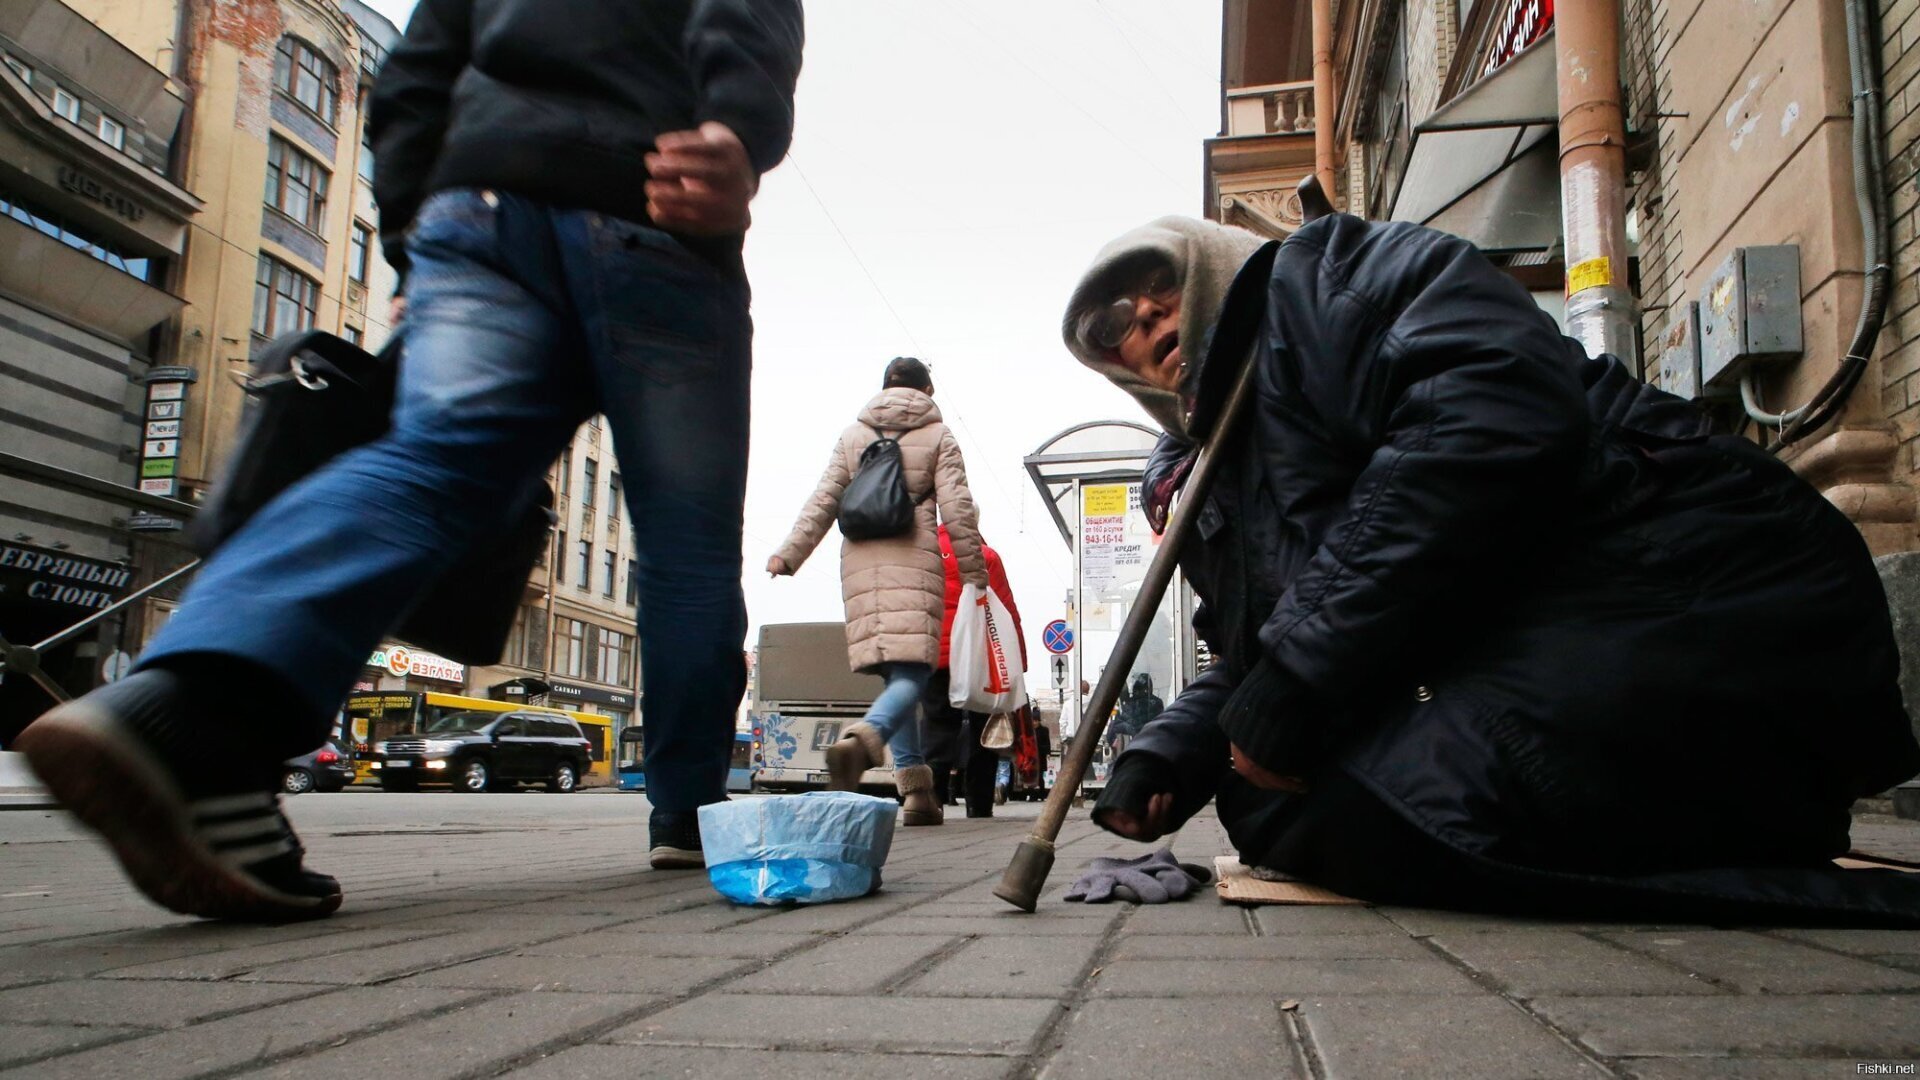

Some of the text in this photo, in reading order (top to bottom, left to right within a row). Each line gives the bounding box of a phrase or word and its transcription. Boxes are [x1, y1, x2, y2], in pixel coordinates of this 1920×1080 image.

[1085, 516, 1123, 525] ОБЩЕЖИТИЕ
[1085, 534, 1123, 544] 943-16-14
[0, 547, 130, 587] ЕБРЯНЫЙ
[412, 663, 462, 681] ВЗГЛЯД
[554, 685, 581, 696] CARNABY
